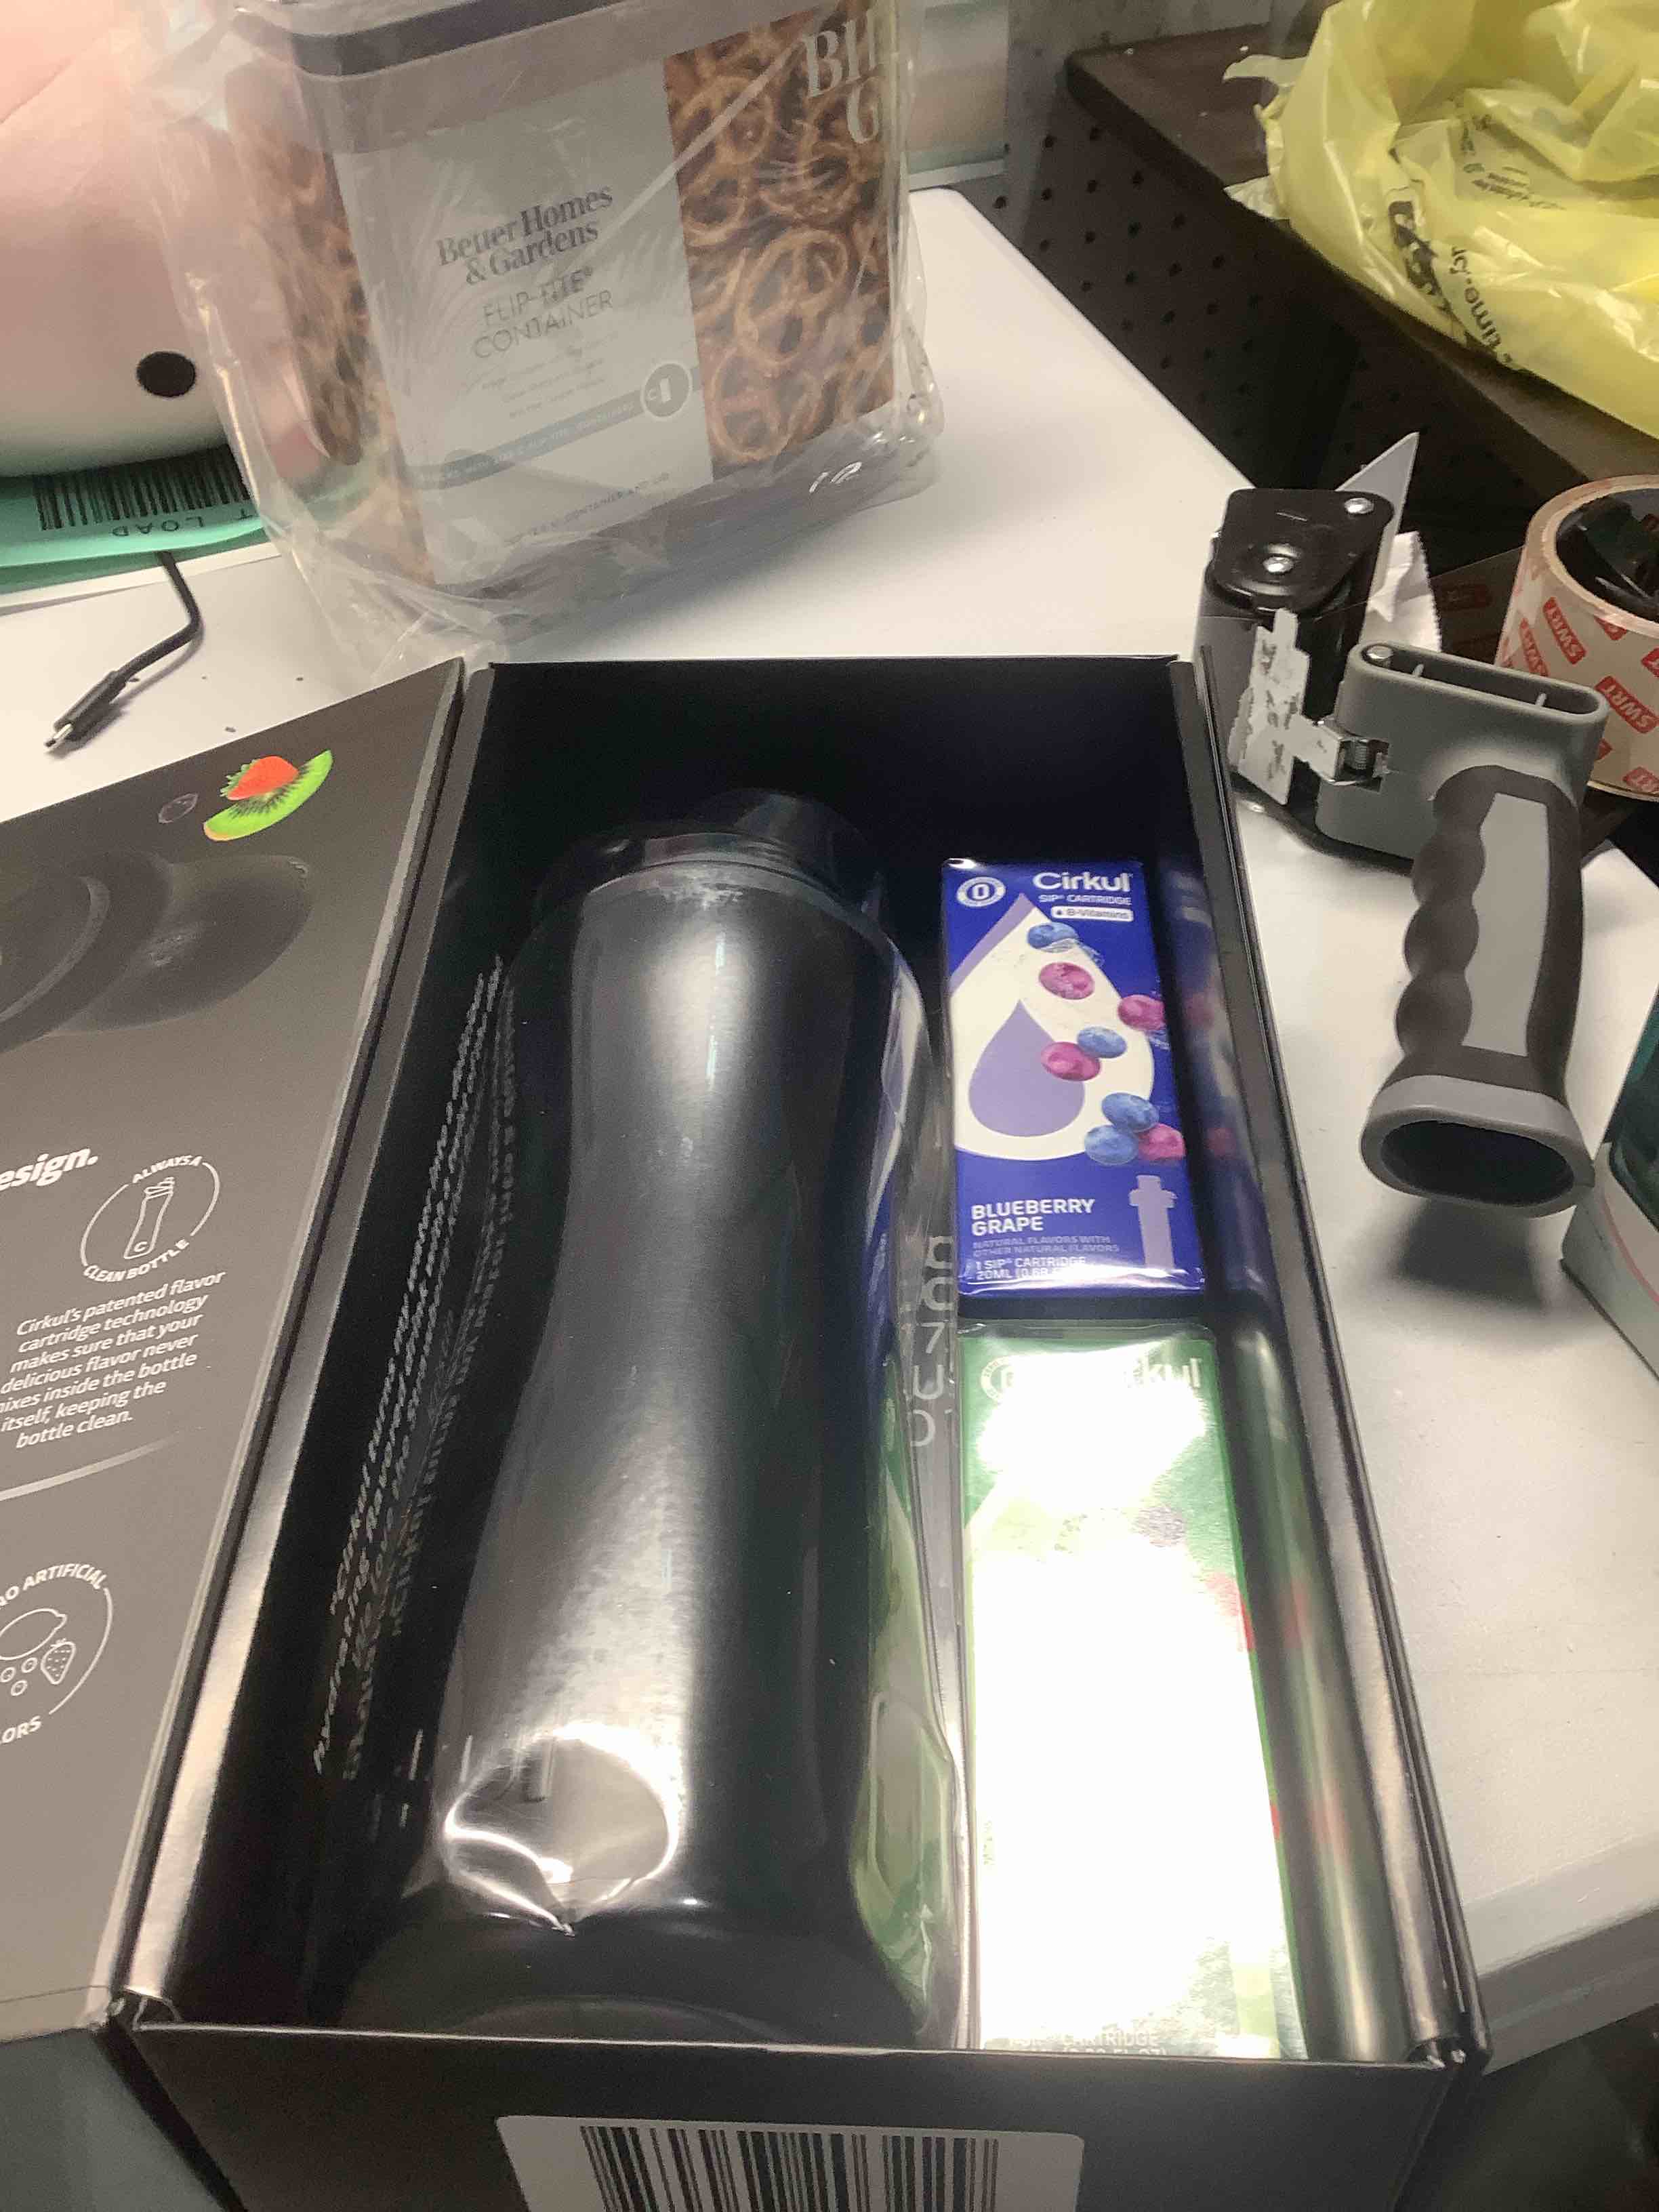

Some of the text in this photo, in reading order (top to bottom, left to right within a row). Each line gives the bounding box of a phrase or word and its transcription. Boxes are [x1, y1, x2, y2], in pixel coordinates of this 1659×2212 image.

[520, 187, 613, 237] Homes
[466, 223, 598, 285] & Gardens
[474, 290, 612, 358] CONTAINER
[112, 515, 205, 537] LOAD
[1033, 872, 1131, 893] Cirkul
[1067, 895, 1132, 905] CARTRIDGE
[1067, 909, 1128, 919] B-Vitamins
[132, 1155, 193, 1183] ALWAYS
[971, 1198, 1095, 1220] BLUEBERRY
[971, 1216, 1044, 1236] GRAPE
[973, 1235, 1111, 1249] NATURAL FLAVORS WITH
[83, 1240, 189, 1282] CLEAN BOTTLE
[973, 1244, 1120, 1258] OTHER NATURAL FLAVORS
[975, 1261, 982, 1270] 1
[1015, 1256, 1087, 1267] CARTRIDGE
[17, 1272, 226, 1335] Cirkul's patented flavor
[18, 1294, 209, 1353] cartridge technology
[9, 1314, 204, 1373] makes sure that your
[0, 1334, 199, 1394] delicious flavor never
[43, 1376, 100, 1402] inside
[102, 1369, 136, 1388] the
[138, 1353, 198, 1379] bottle
[0, 1381, 167, 1432] itself, keeping the
[16, 1410, 134, 1448] bottle clean.
[23, 1563, 106, 1590] ARTIFICIAL
